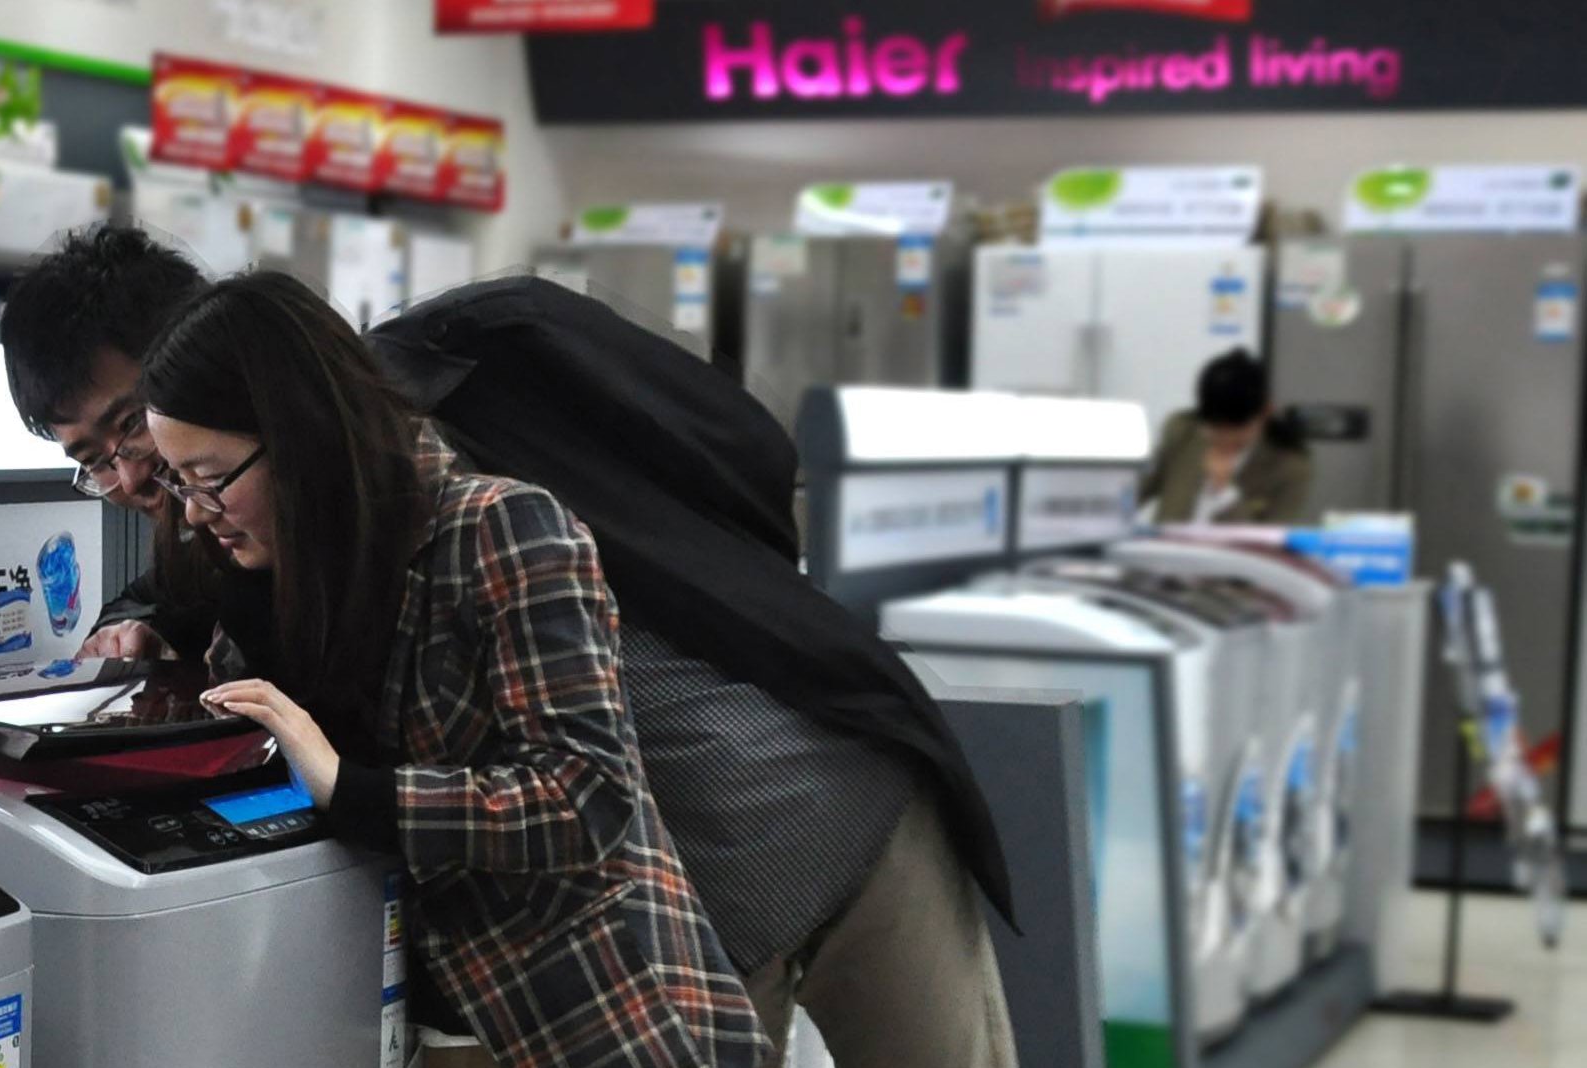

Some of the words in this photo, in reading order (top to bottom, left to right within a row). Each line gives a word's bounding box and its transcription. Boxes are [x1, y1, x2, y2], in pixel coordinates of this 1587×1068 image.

[703, 17, 969, 98] Haier
[1014, 36, 1231, 103] inspired
[1249, 34, 1401, 98] living
